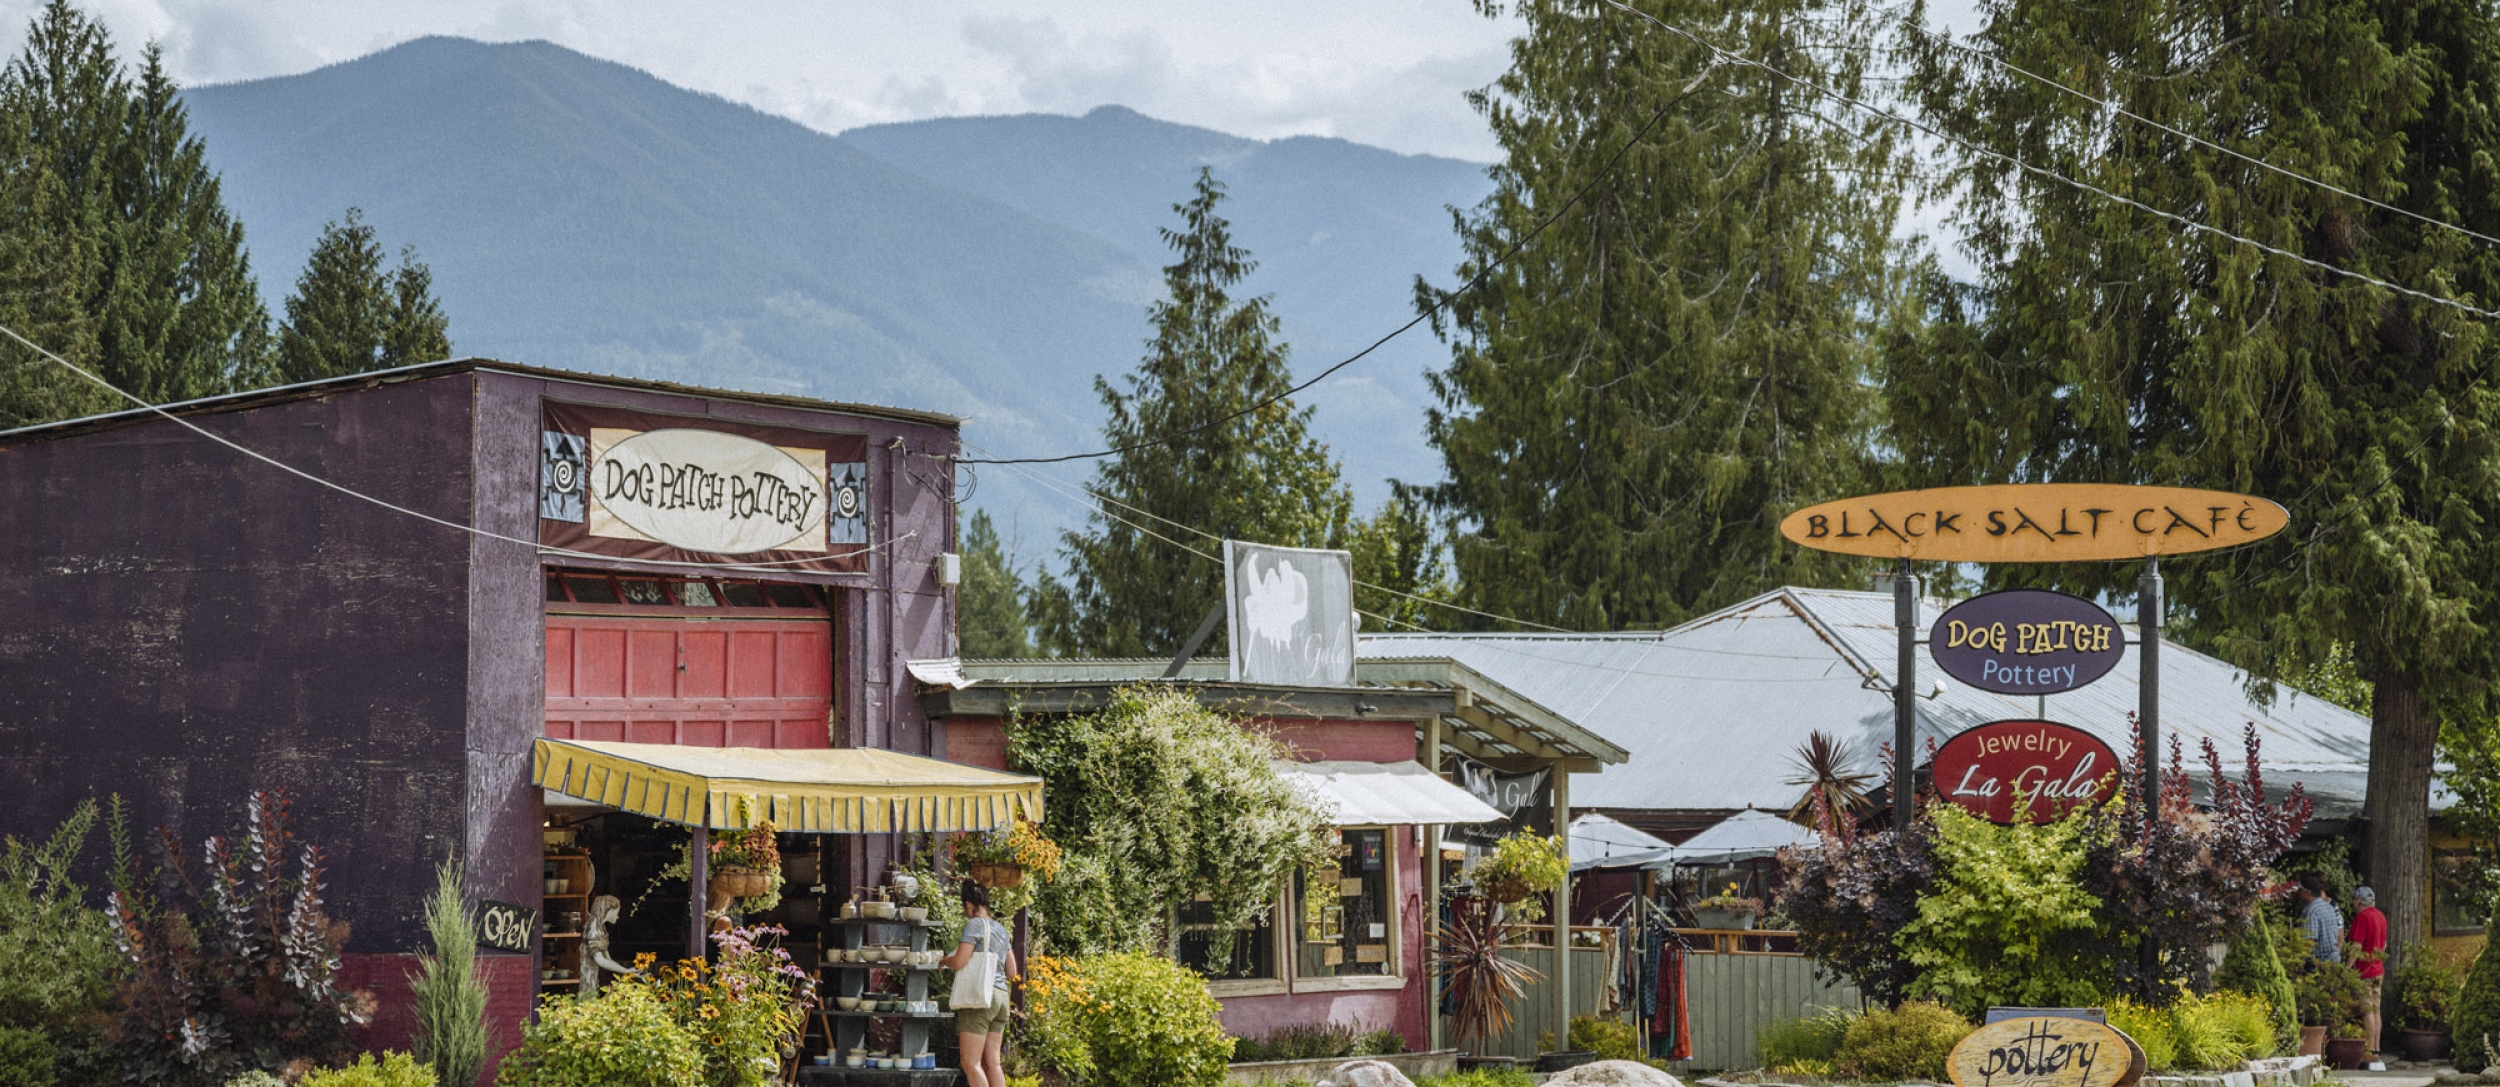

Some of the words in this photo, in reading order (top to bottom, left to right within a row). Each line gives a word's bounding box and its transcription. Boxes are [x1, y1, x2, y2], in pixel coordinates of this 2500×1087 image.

[605, 458, 654, 507] DOG
[658, 462, 725, 511] PATCH
[730, 471, 817, 532] POTTERY
[1805, 507, 1964, 543] BLACK
[1985, 506, 2115, 543] SALT
[1947, 619, 2008, 654] DOG
[2016, 620, 2113, 655] PATCH
[1982, 658, 2076, 689] Pottery
[1976, 729, 2072, 761] Jewelry
[1951, 763, 2001, 797] La
[2013, 751, 2099, 812] Gala
[1978, 1018, 2100, 1087] pottery
